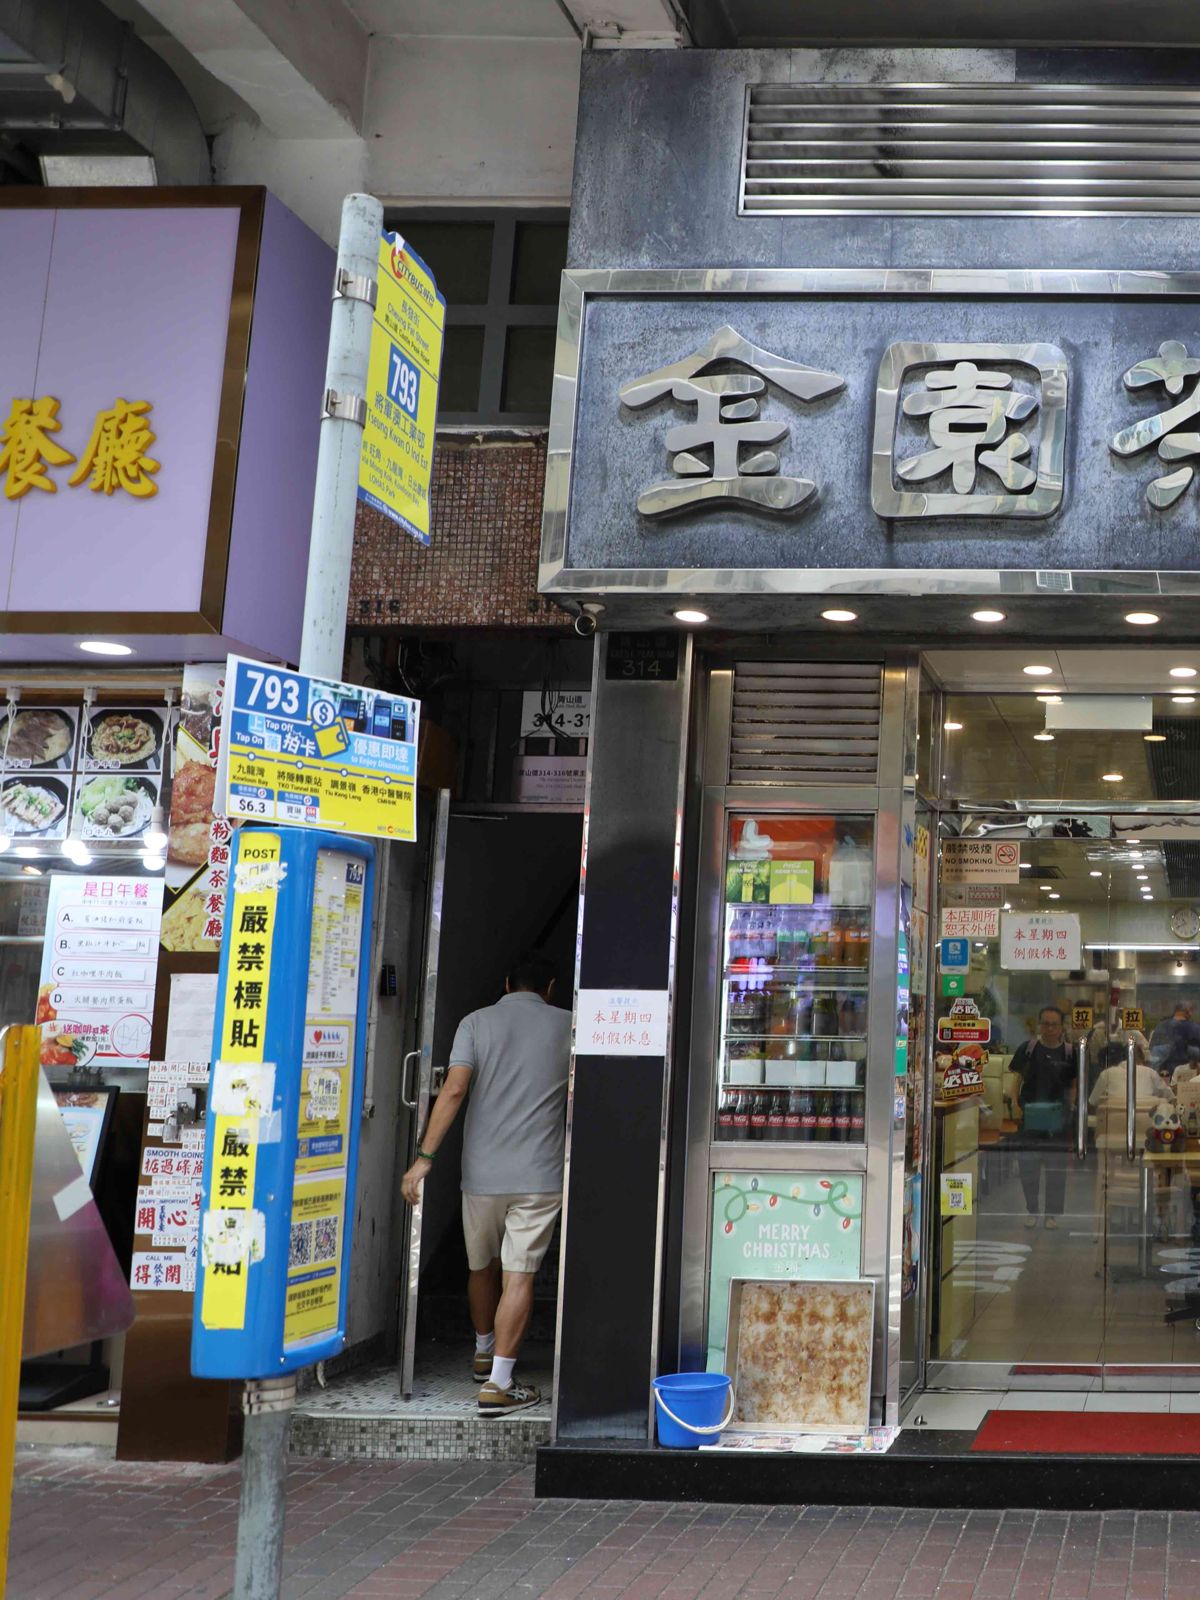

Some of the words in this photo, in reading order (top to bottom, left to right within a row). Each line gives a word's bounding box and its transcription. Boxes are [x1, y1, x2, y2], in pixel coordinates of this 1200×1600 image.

[391, 352, 418, 413] 793
[0, 395, 161, 500] 餐廳
[621, 659, 662, 677] 314
[246, 669, 300, 715] 793
[265, 719, 279, 730] Tap
[280, 722, 294, 733] Off
[236, 732, 251, 746] Tap
[251, 734, 263, 745] On
[353, 739, 409, 764] 優惠即達
[237, 763, 266, 779] 九龍灣
[232, 774, 257, 784] Kowloon
[362, 784, 413, 801] 香港中醫醫院
[239, 799, 266, 814] $6.3
[243, 849, 277, 859] POST
[945, 843, 992, 855] 嚴禁吸煙
[84, 882, 149, 898] 是日午餐
[944, 923, 997, 936] 恕不外借
[1014, 929, 1068, 941] 本星期四
[1013, 946, 1068, 961] 例假休息
[230, 905, 268, 1049] 嚴禁標貼
[593, 1009, 653, 1025] 本星期四
[1075, 1009, 1090, 1022] 拉
[1125, 1010, 1140, 1022] 拉
[591, 1031, 652, 1046] 例假休息
[147, 1149, 180, 1158] SMOOTH
[758, 1223, 811, 1240] MERRY
[742, 1243, 831, 1259] CHRISTMAS
